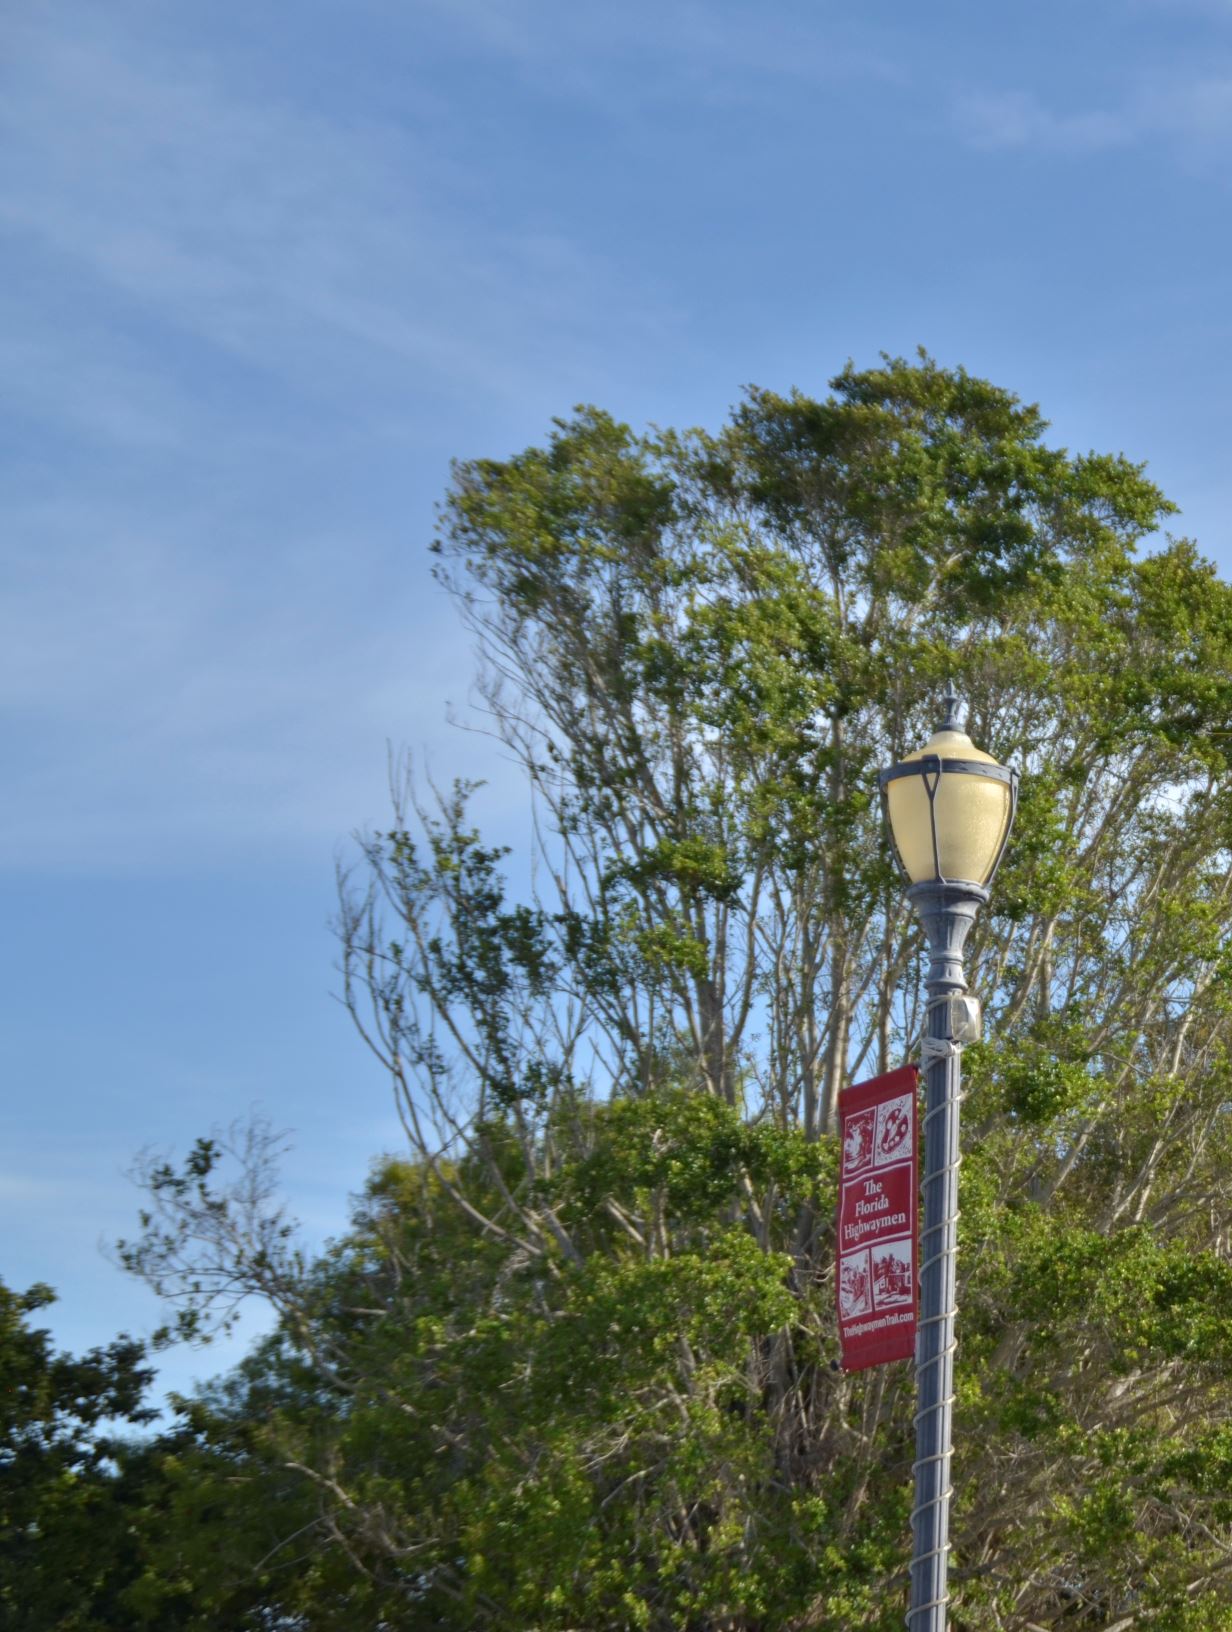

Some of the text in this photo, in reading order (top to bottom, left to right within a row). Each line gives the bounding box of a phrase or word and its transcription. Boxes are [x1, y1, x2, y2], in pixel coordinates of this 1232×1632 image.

[864, 1179, 882, 1196] The
[855, 1194, 889, 1217] Florida
[844, 1212, 906, 1241] Highwaymen
